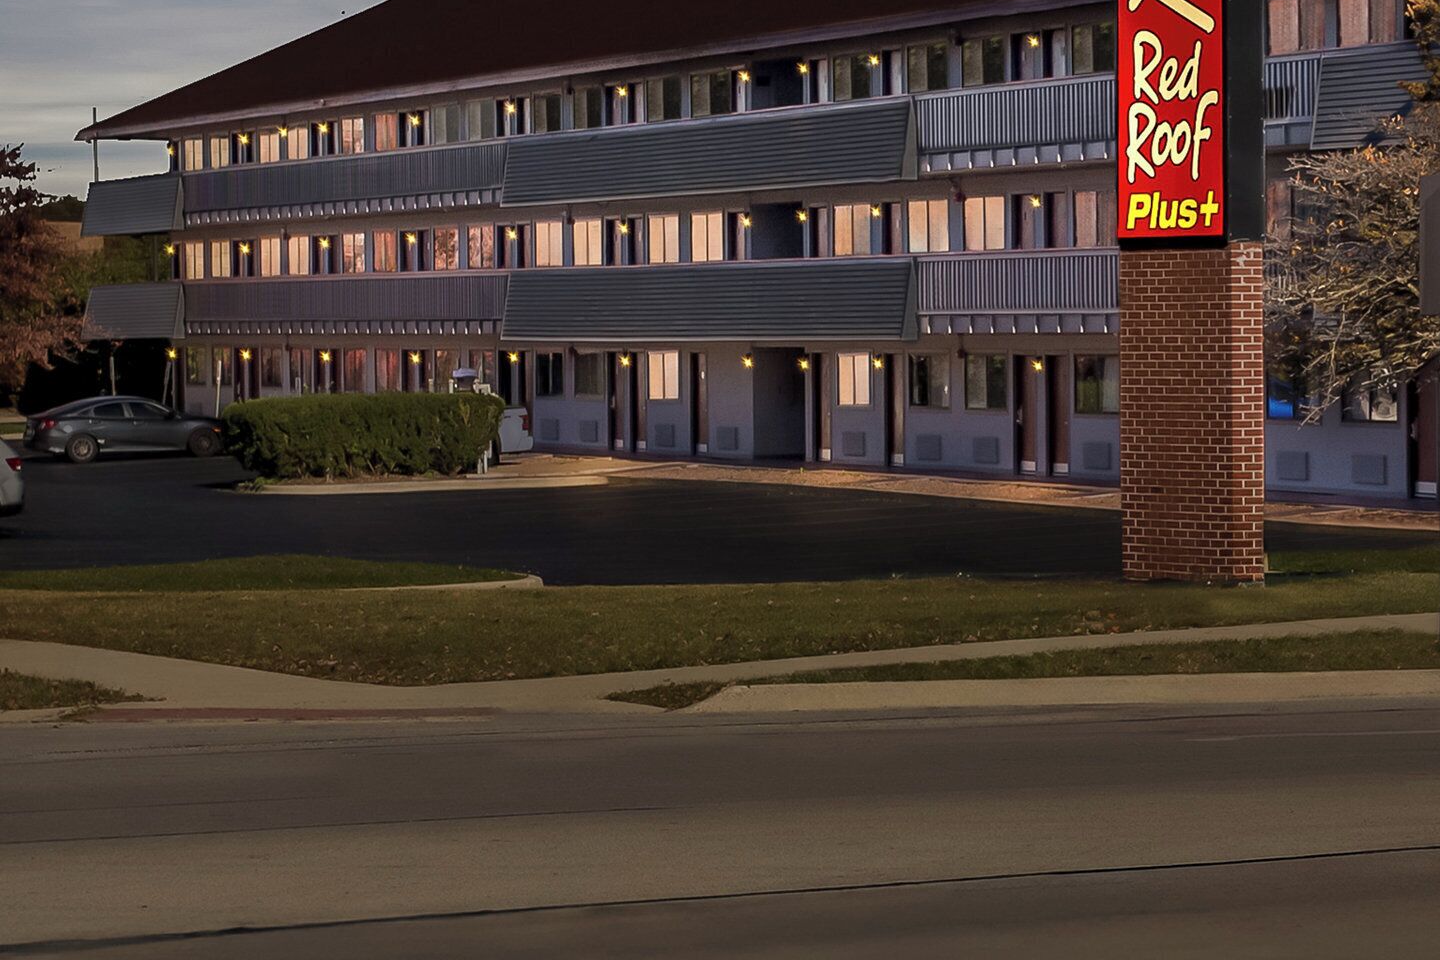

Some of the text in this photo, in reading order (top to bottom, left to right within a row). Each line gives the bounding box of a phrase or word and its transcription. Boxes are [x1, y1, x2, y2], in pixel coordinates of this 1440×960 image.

[1133, 30, 1202, 104] Red
[1126, 90, 1219, 183] Roof
[1127, 191, 1219, 230] Plus+
